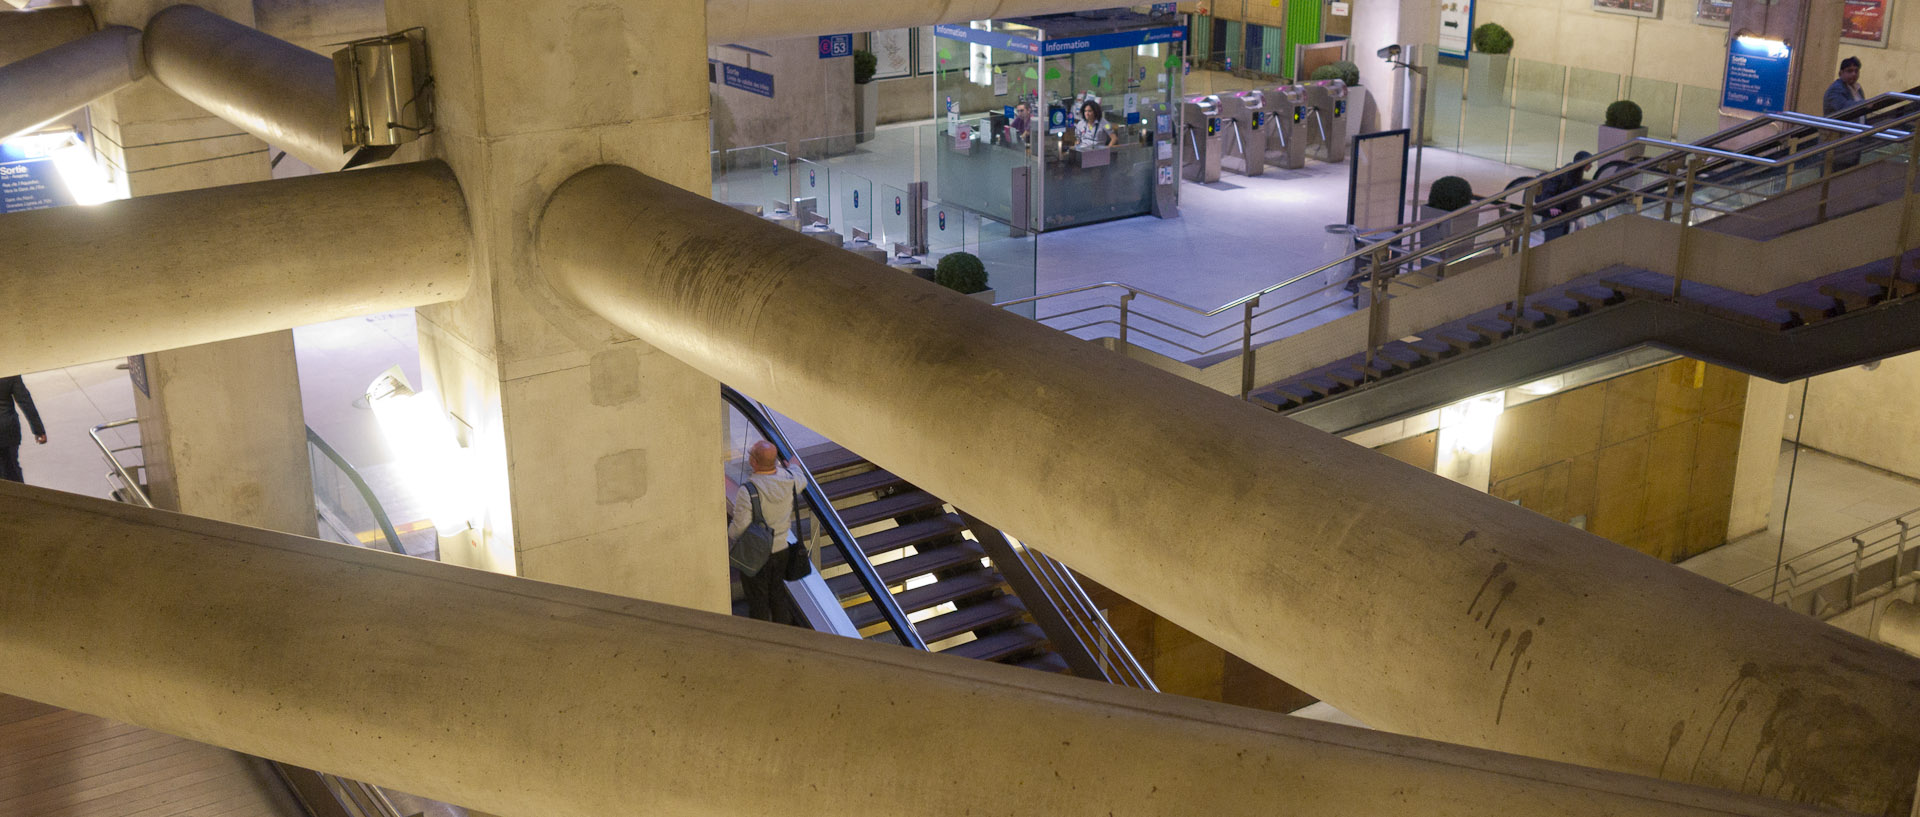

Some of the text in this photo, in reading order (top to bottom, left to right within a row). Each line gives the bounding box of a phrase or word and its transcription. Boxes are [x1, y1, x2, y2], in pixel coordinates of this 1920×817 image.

[936, 25, 967, 38] Information
[833, 42, 846, 53] 53
[1045, 40, 1090, 52] Information
[0, 165, 27, 175] Sortie
